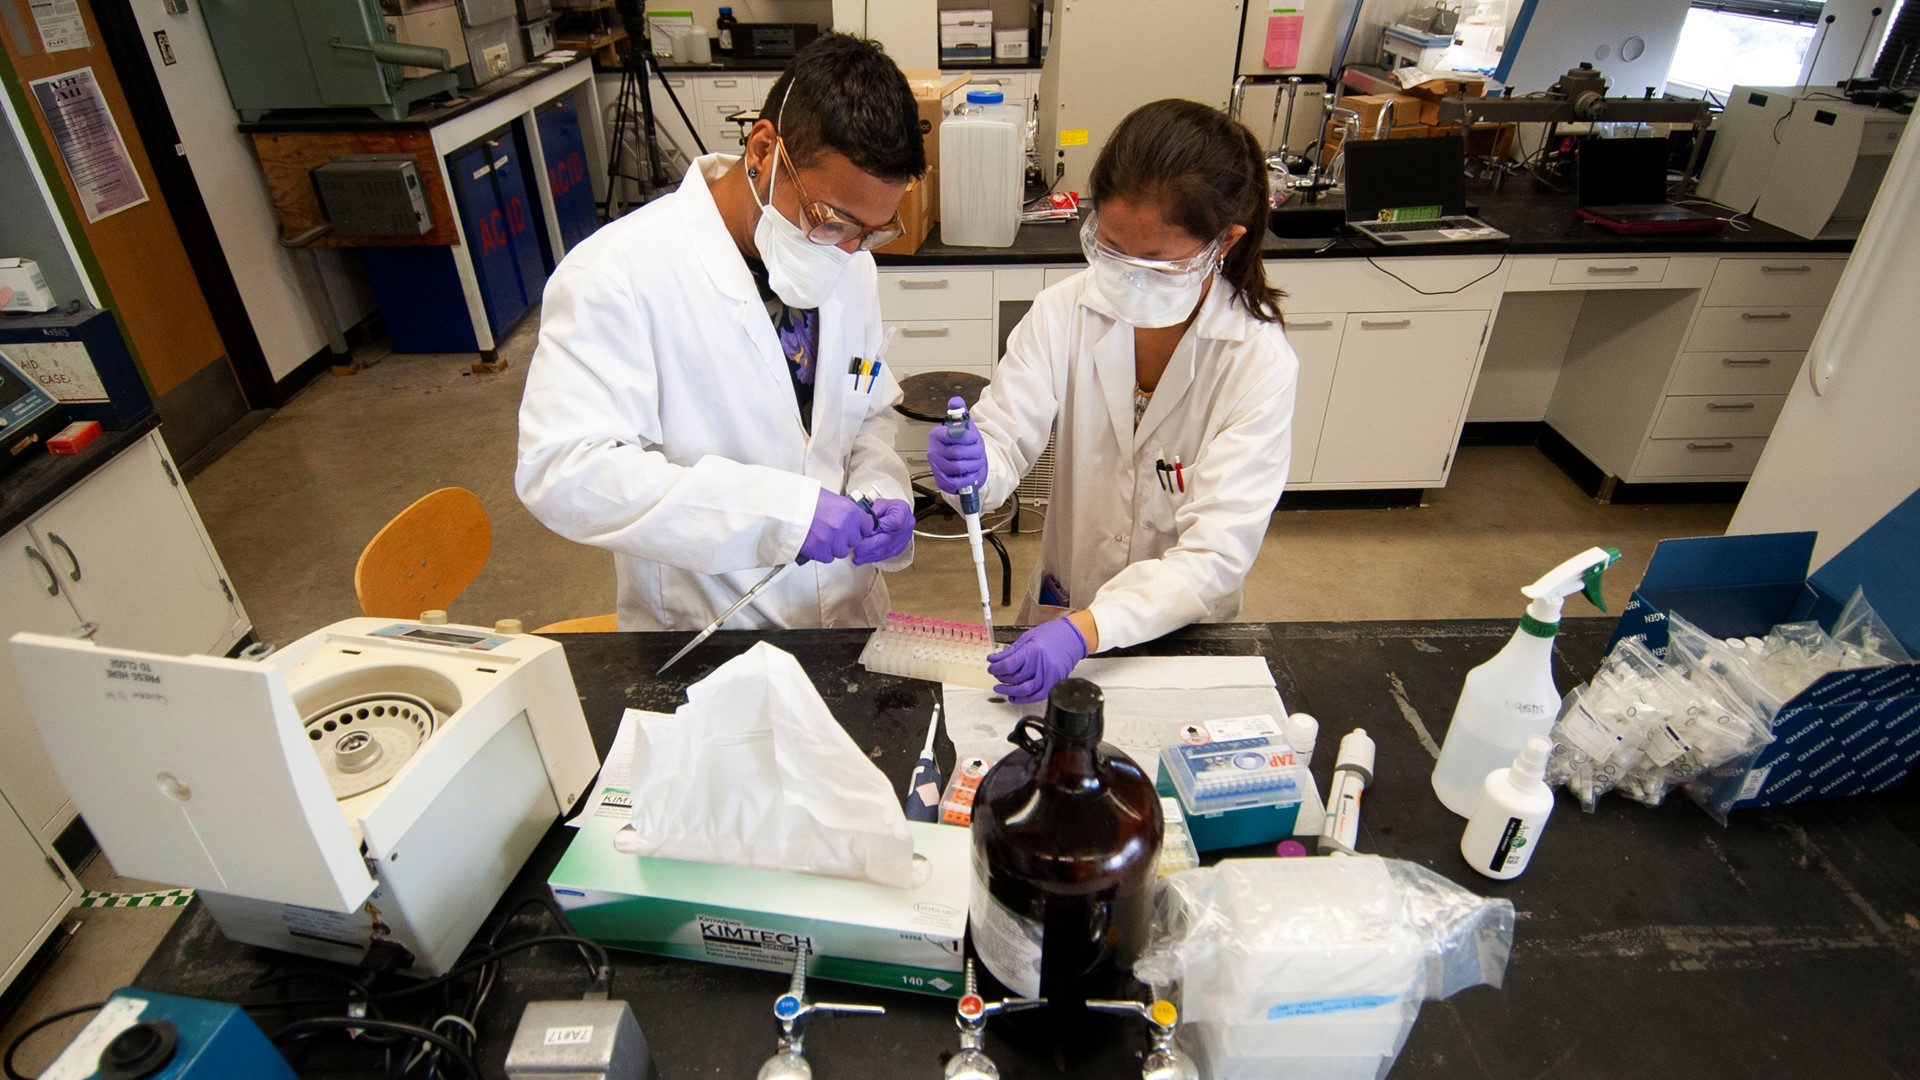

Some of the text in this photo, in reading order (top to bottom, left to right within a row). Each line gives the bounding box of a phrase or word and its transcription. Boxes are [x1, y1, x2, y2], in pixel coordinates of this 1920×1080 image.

[550, 152, 584, 200] ACID
[480, 196, 525, 256] ACID
[20, 360, 39, 370] AID
[39, 375, 67, 385] CASE
[131, 672, 160, 684] PRESS
[140, 663, 152, 672] TO
[1830, 700, 1868, 728] QIAGEN
[1785, 718, 1824, 745] QIAGEN
[1841, 719, 1879, 746] QIAGEN
[1894, 726, 1920, 746] QIAG
[1269, 753, 1297, 767] ZAP
[1797, 735, 1835, 762] QIAGEN
[1852, 736, 1889, 763] QIAGEN
[1808, 752, 1846, 779] QIAGEN
[1862, 753, 1899, 779] QIAGEN
[1765, 769, 1802, 795] QIAGEN
[1820, 769, 1856, 794] QIAGEN
[699, 915, 741, 926] Kimwipes
[700, 922, 811, 949] KIMTECH
[952, 940, 958, 952] 1
[902, 975, 923, 986] 140
[548, 1029, 588, 1042] 7A#17
